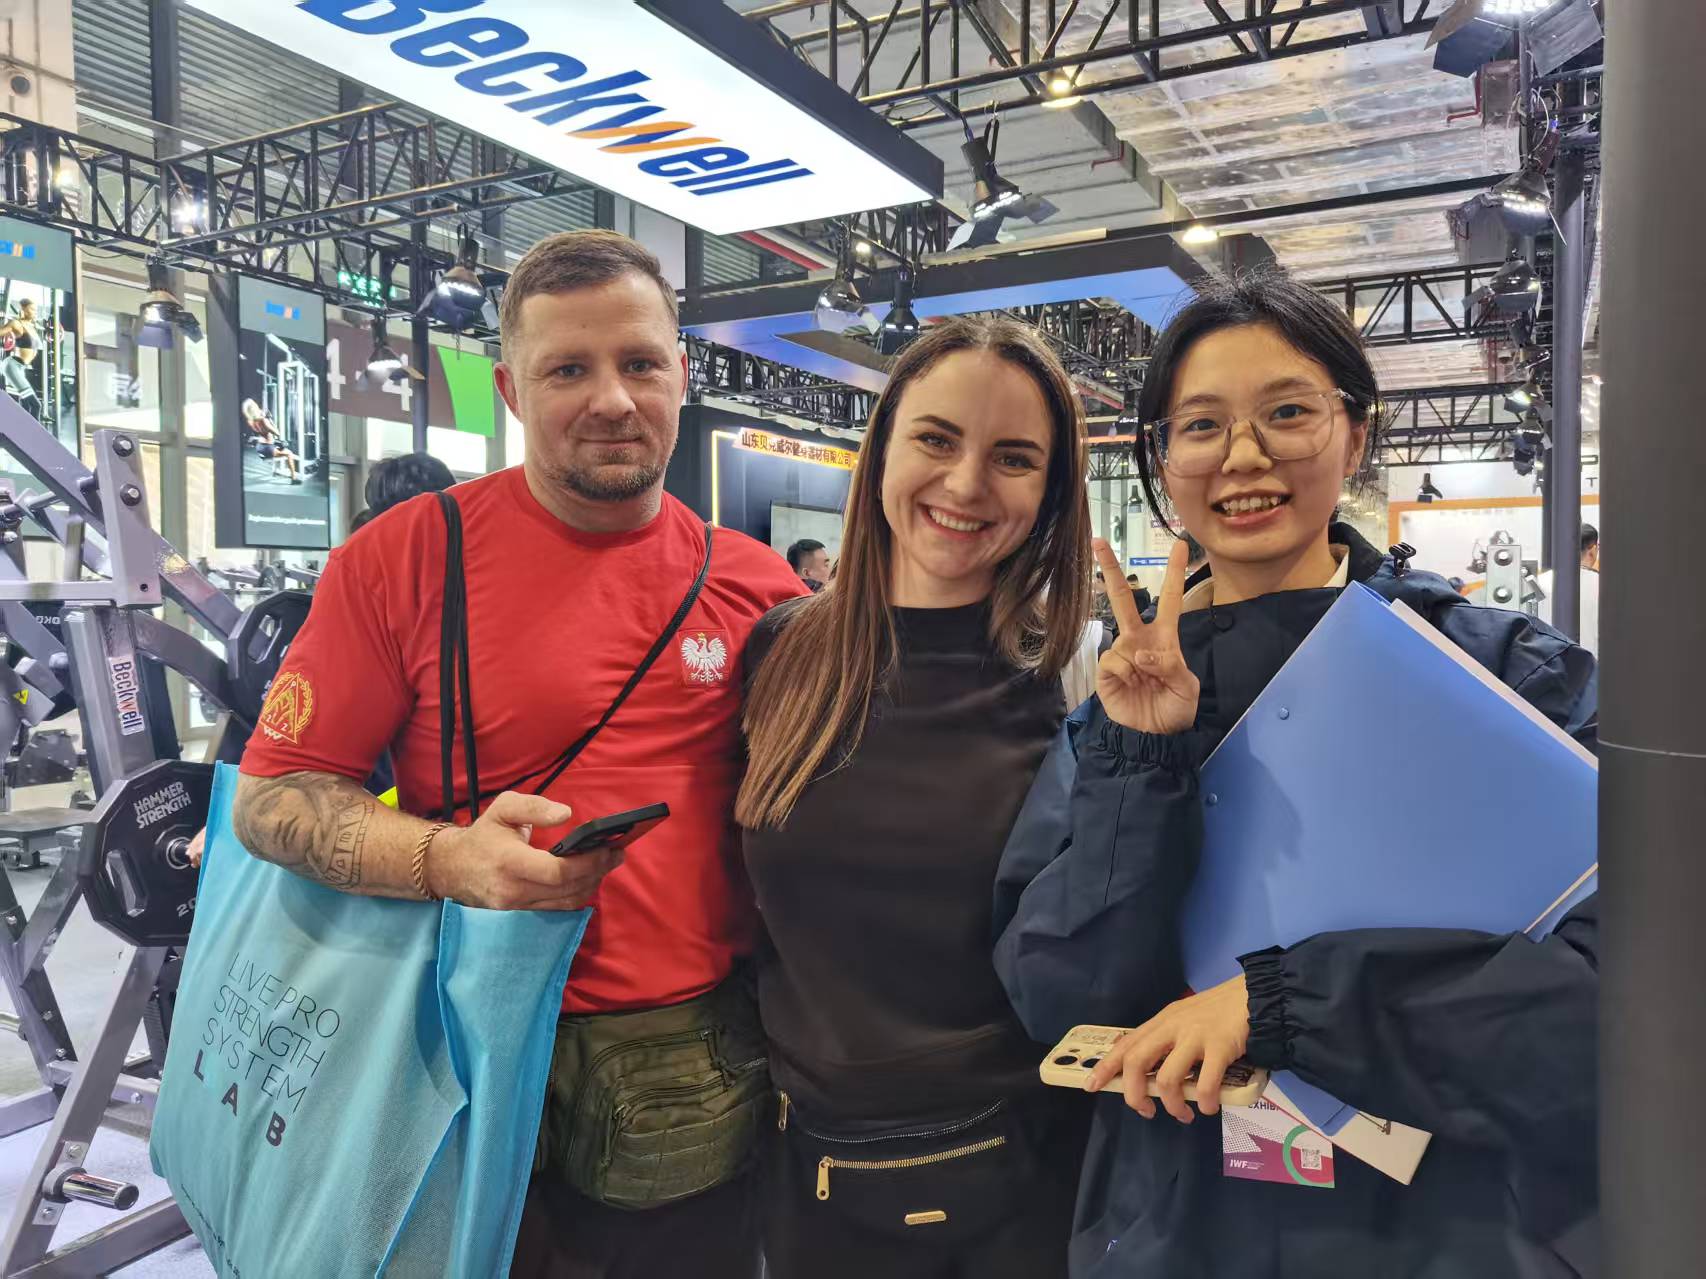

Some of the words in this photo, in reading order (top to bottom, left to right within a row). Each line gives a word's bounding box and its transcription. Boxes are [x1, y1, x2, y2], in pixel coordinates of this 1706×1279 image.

[112, 661, 143, 730] Beckwell
[133, 781, 185, 816] HAMMER
[136, 792, 192, 830] STRENGTH
[214, 984, 326, 1078] STRENGTH
[203, 1017, 308, 1113] SYSTEM
[1230, 1159, 1248, 1169] IWF
